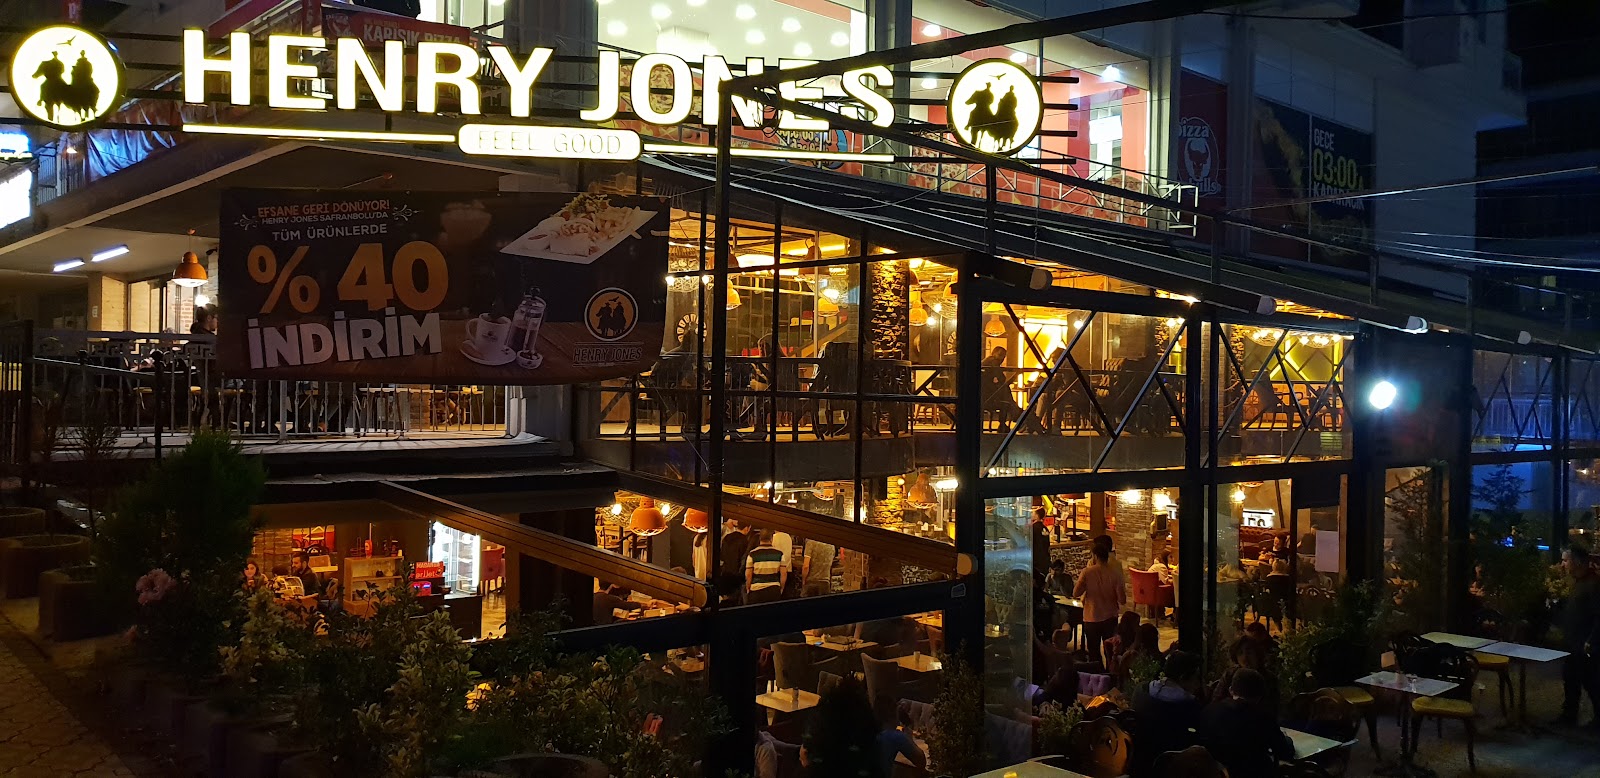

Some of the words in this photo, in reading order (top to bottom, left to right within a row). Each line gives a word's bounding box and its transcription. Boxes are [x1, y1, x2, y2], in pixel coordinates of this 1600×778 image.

[184, 29, 553, 117] HENRY
[580, 50, 895, 131] JONES
[478, 130, 544, 151] FEEL
[553, 133, 621, 154] GOOD
[1313, 128, 1336, 151] GECE
[258, 205, 299, 218] EFSANE
[302, 202, 330, 214] GERİ
[262, 216, 289, 225] HENRY
[290, 214, 318, 223] JONES
[320, 211, 388, 222] SAFRANBOLU'DA
[272, 228, 301, 241] TÜM
[307, 223, 388, 239] ÜRÜNLERDE
[337, 241, 449, 311] 40
[248, 307, 442, 369] İNDİRİM
[573, 347, 609, 362] HENRY
[611, 346, 643, 362] JONES
